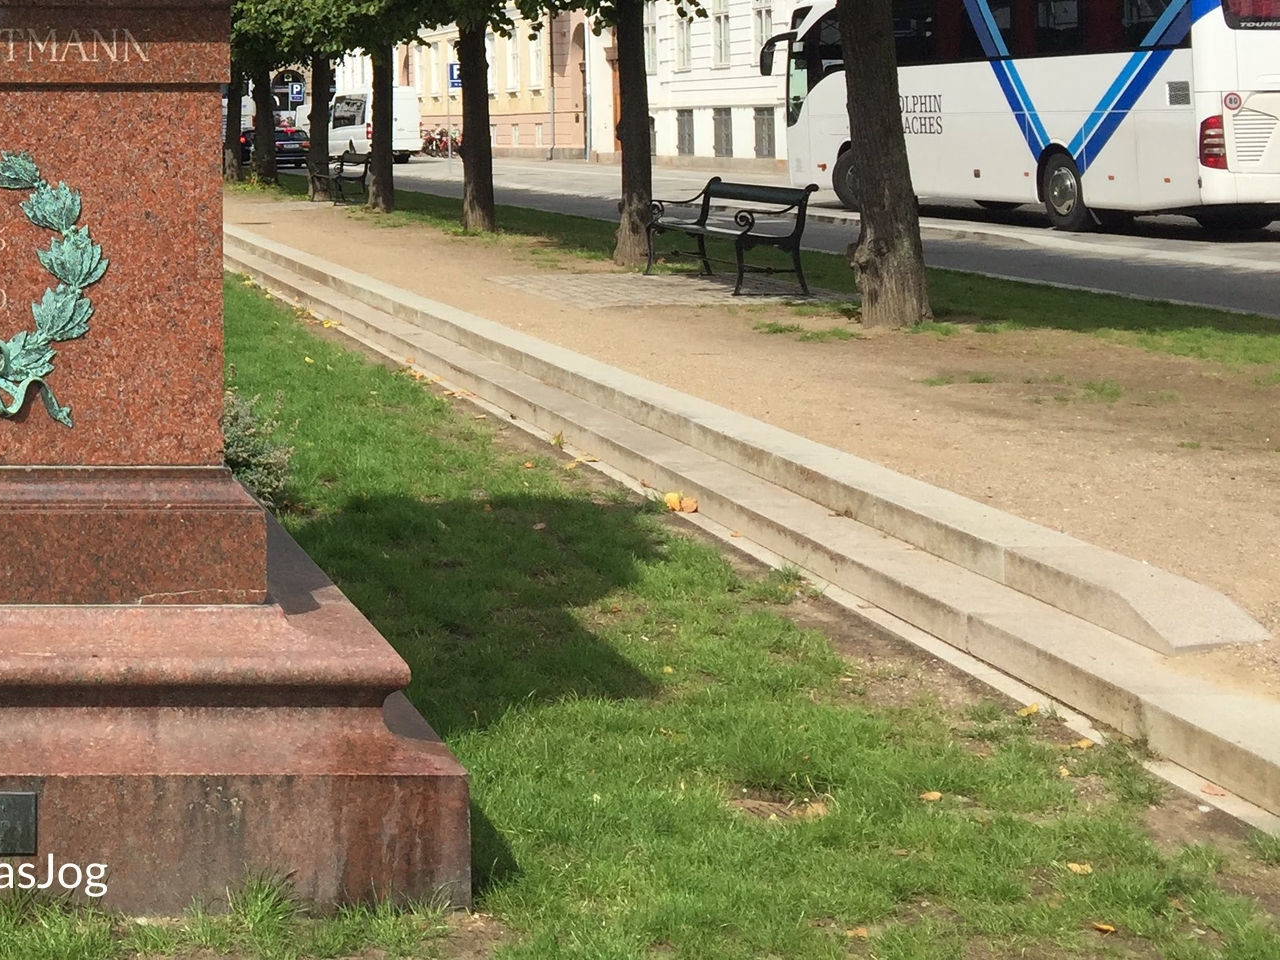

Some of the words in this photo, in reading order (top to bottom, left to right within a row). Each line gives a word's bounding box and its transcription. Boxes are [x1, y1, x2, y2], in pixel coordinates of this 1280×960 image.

[293, 84, 300, 95] P
[900, 95, 942, 113] OLPHIN
[1228, 97, 1238, 105] 80
[903, 116, 943, 135] ACHES
